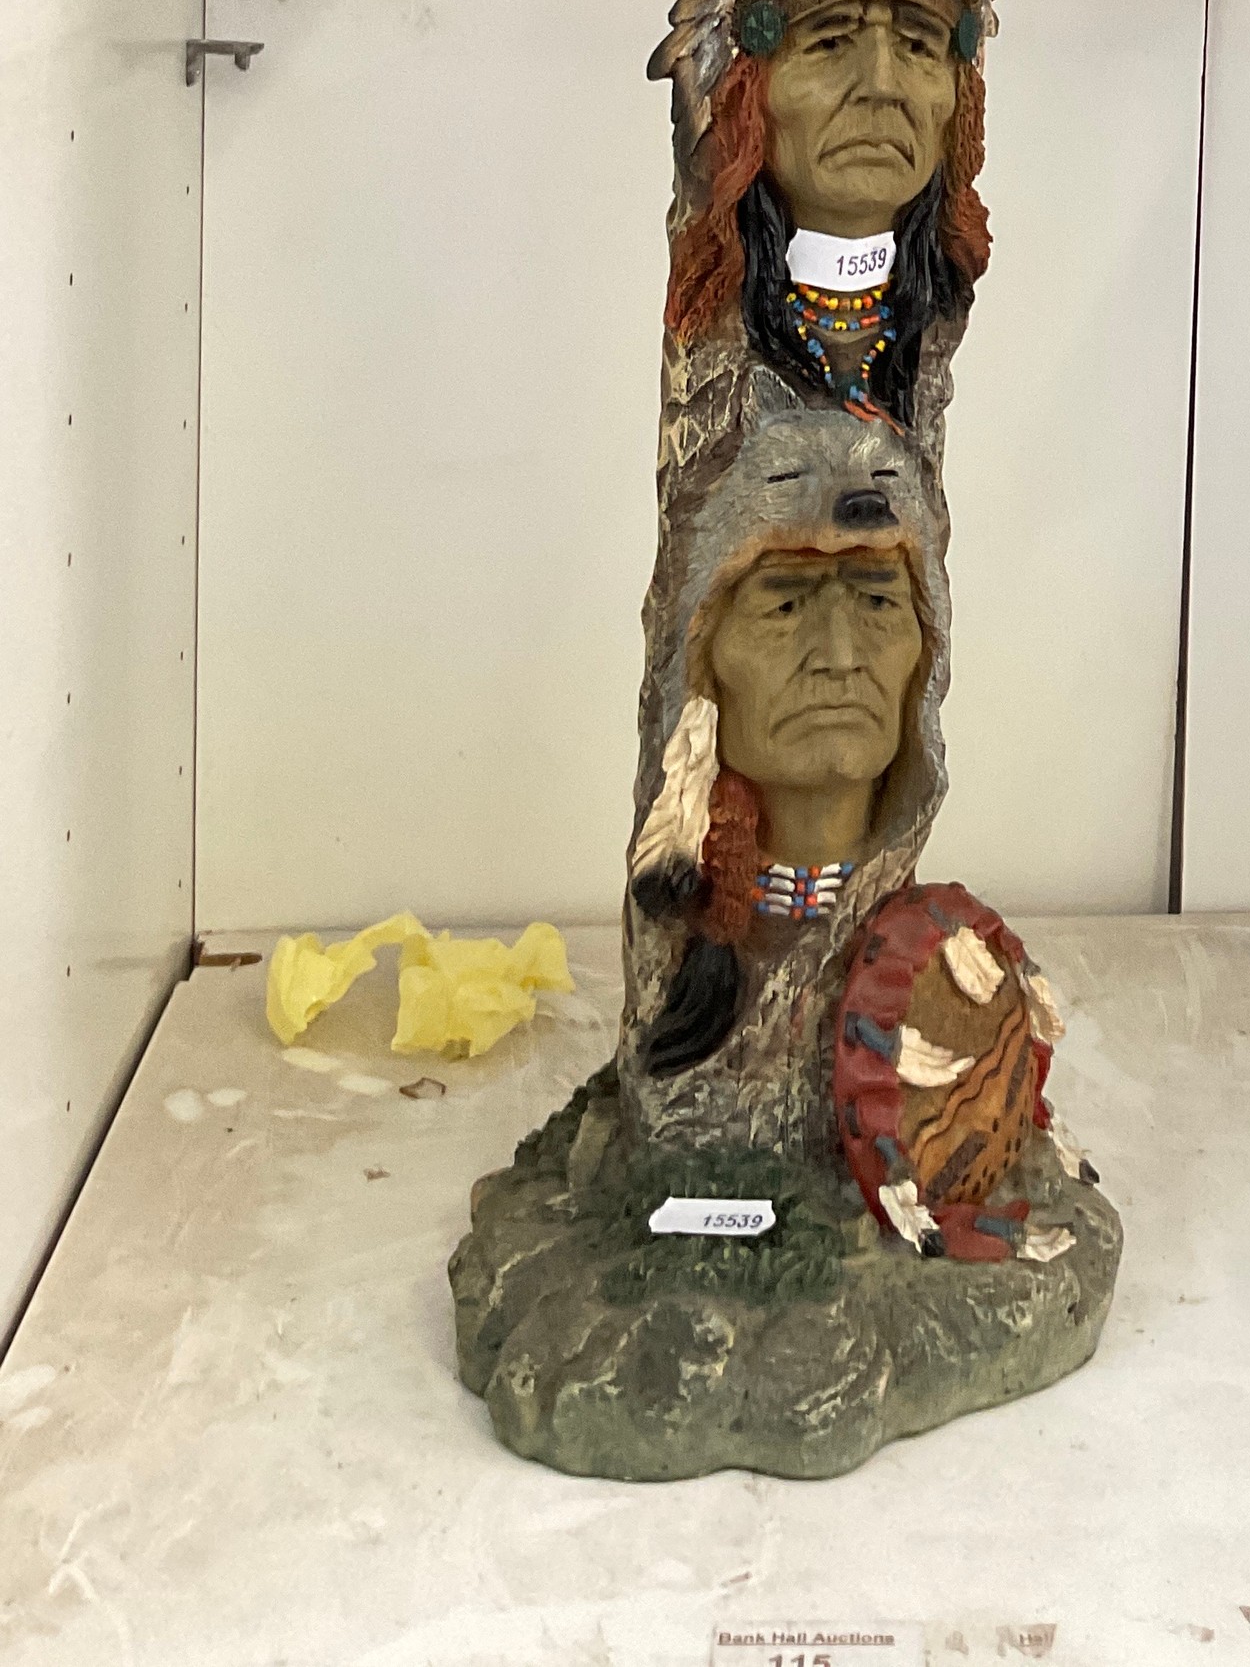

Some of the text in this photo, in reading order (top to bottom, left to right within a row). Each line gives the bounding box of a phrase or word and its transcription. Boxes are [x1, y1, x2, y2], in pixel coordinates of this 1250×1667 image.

[836, 247, 888, 276] 15539
[703, 1214, 763, 1229] 15539
[719, 1632, 895, 1644] Bank Hall Auctions
